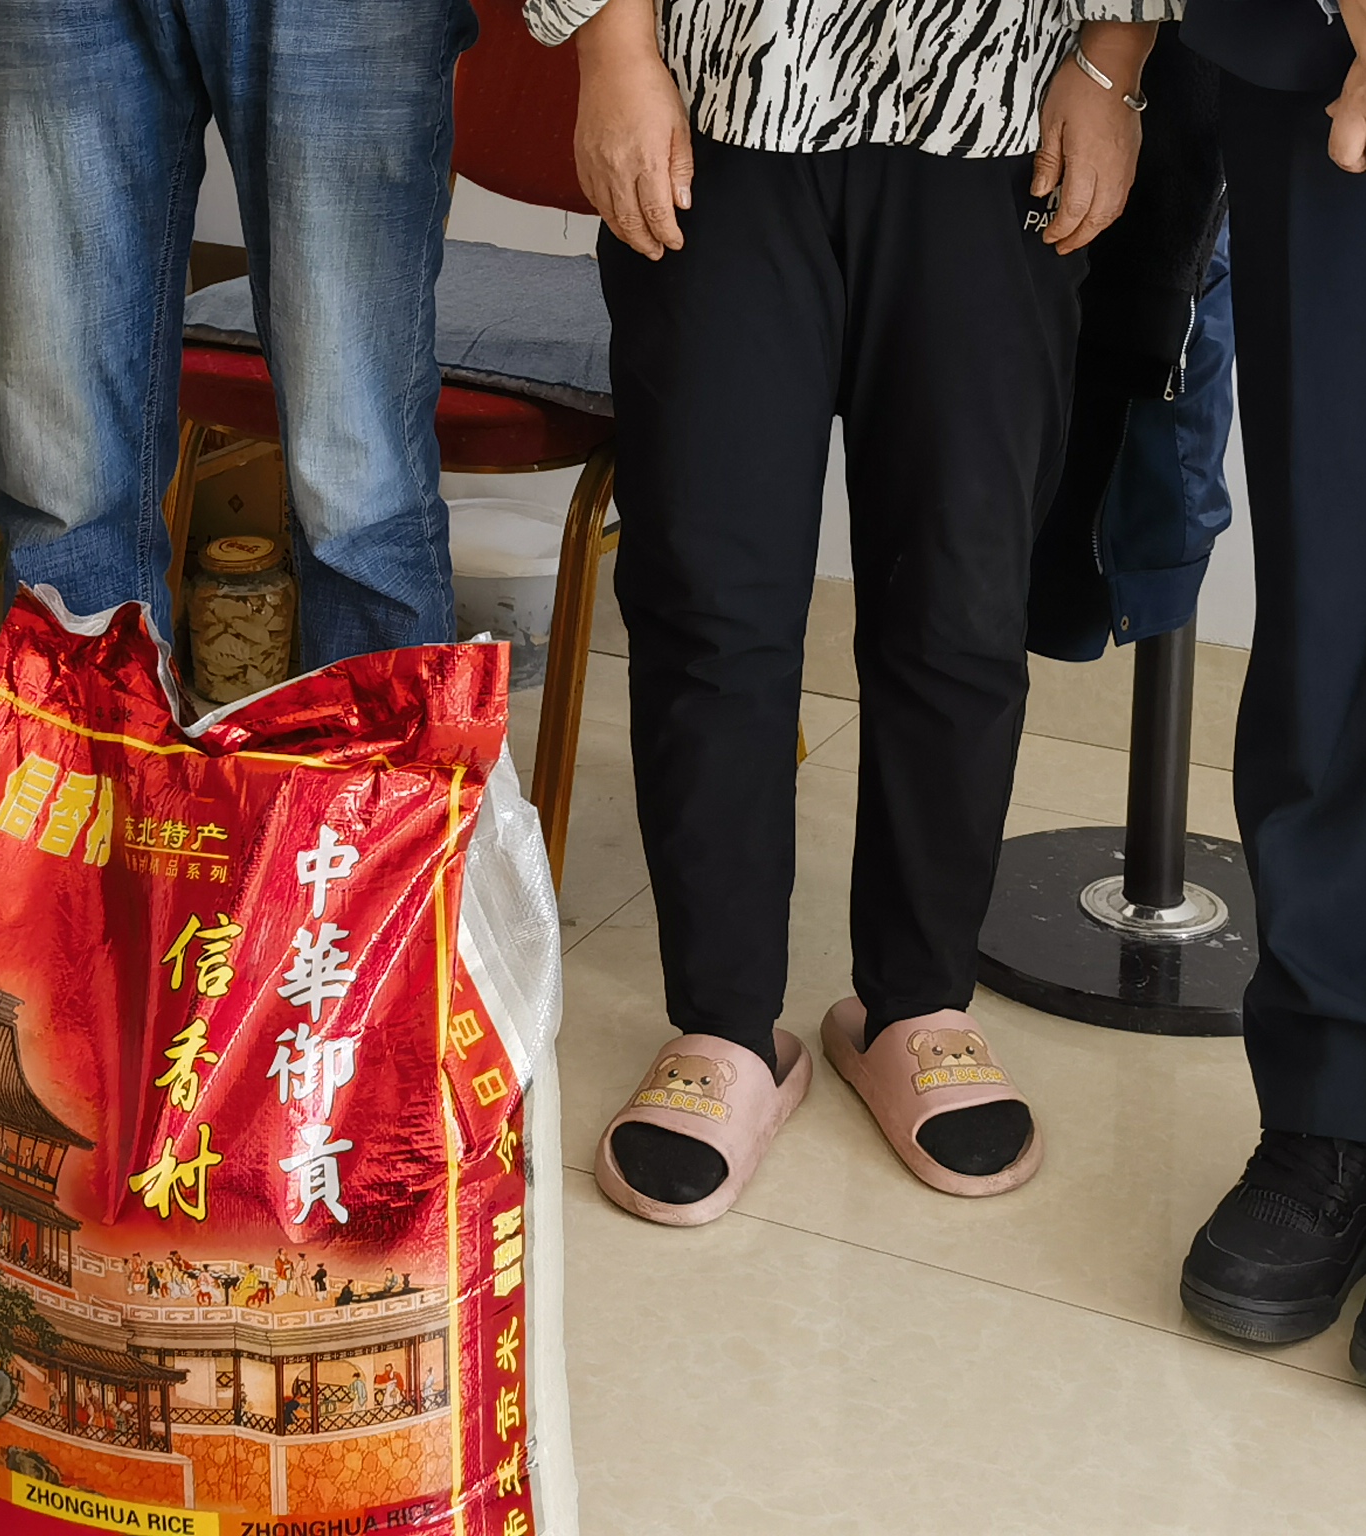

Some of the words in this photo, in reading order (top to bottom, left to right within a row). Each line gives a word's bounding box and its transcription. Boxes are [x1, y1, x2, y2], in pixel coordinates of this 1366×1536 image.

[125, 852, 228, 884] 精品系列
[265, 823, 360, 1225] 中華御貢
[129, 912, 243, 1221] 信香村
[25, 1483, 140, 1528] ZHONGHUA
[147, 1512, 195, 1536] RICE
[240, 1514, 379, 1536] ZHONGHUA
